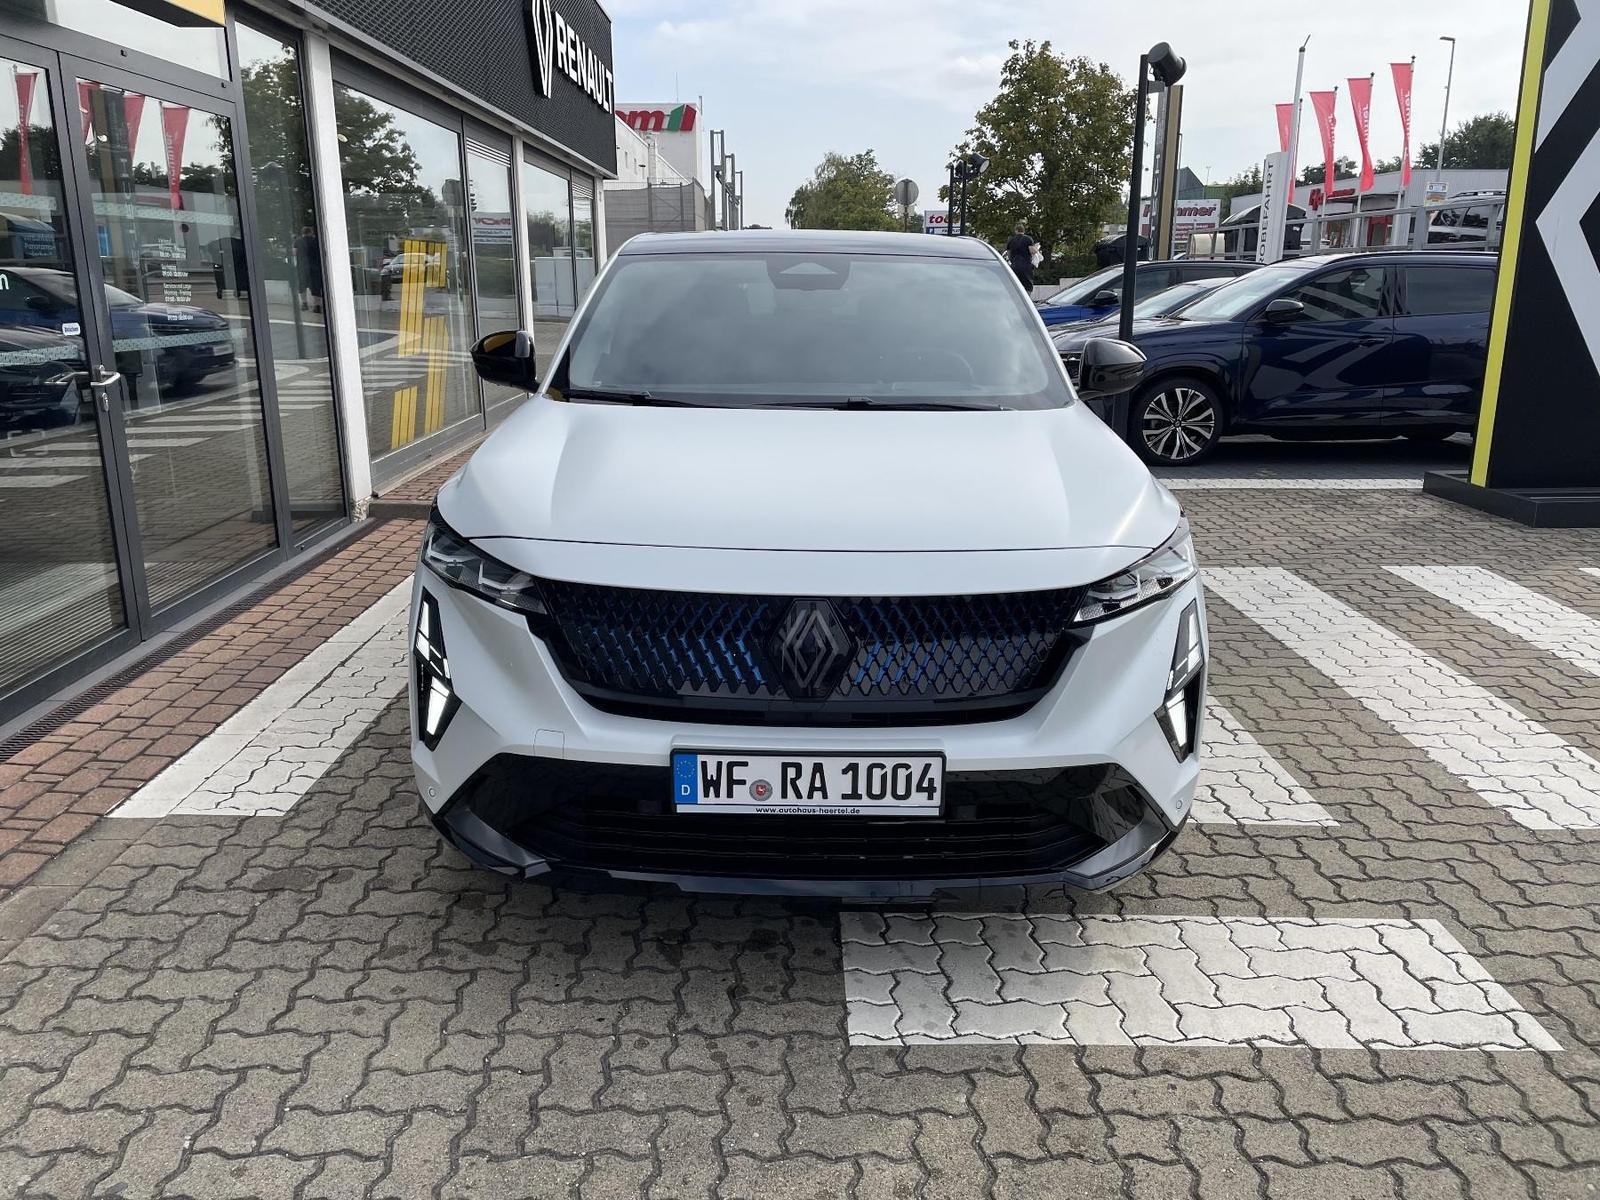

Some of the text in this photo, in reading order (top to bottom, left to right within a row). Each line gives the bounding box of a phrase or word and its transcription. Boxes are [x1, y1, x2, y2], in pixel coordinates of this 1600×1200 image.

[555, 11, 613, 114] RENAULT
[681, 760, 938, 800] D WF RA 1004
[755, 807, 860, 815] www.autohaus-haertel.de
